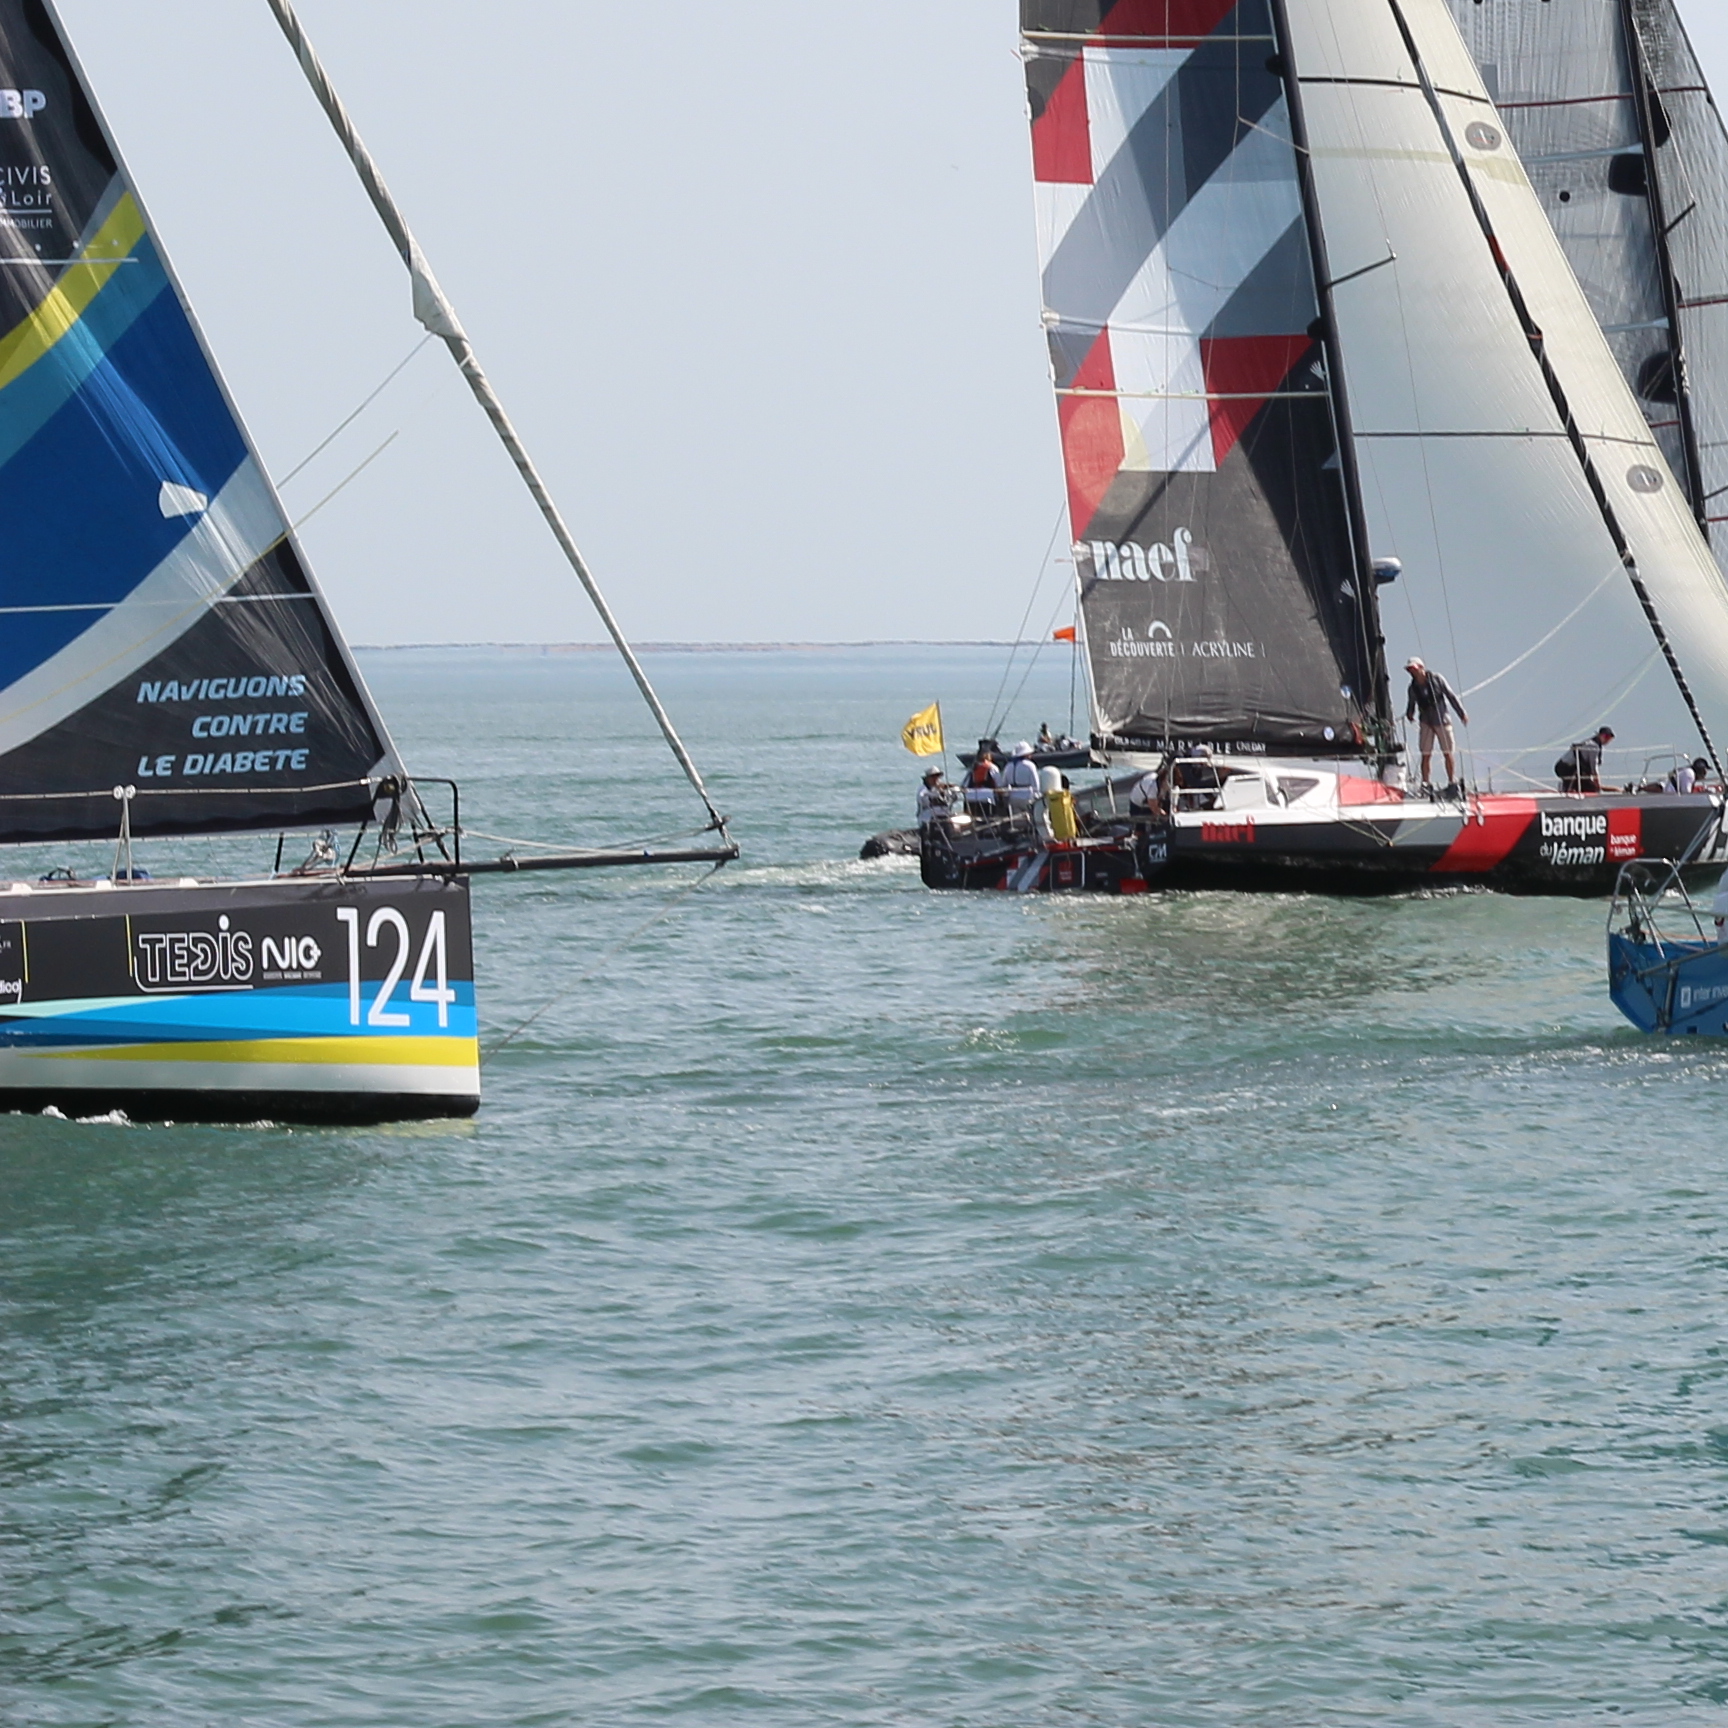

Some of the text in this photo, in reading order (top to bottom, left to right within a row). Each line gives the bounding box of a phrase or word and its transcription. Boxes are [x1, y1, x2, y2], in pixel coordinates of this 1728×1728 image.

[11, 190, 53, 207] Loir
[1087, 526, 1197, 583] naef
[1110, 638, 1255, 658] DÉCOUVERTE ACRYLINE
[1121, 627, 1134, 642] LA
[136, 674, 307, 704] NAVIGUONS
[191, 712, 309, 739] CONTRE
[137, 749, 310, 777] LE DIABETE
[1540, 811, 1608, 841] banque
[1539, 841, 1605, 866] du léman
[335, 906, 457, 1028] 124
